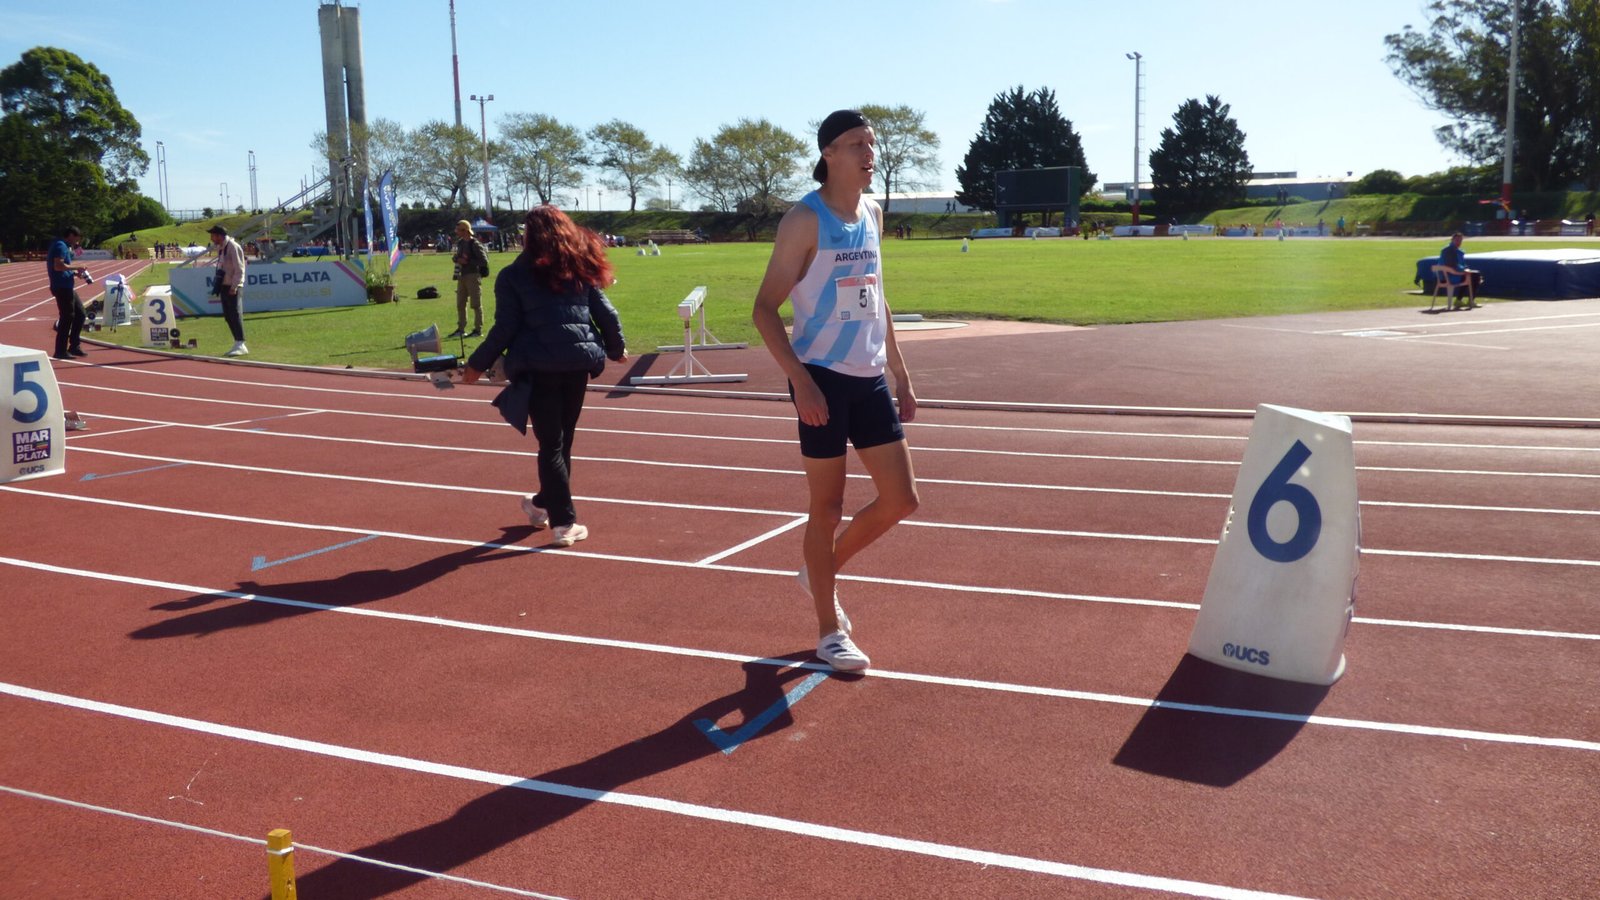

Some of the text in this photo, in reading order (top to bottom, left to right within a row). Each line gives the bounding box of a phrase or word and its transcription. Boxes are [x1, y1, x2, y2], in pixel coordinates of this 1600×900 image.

[835, 250, 877, 262] ARGENTINA
[247, 271, 331, 286] DEL PLATA
[859, 288, 868, 308] 5
[149, 298, 167, 325] 3
[12, 360, 49, 424] 5
[15, 429, 49, 444] MAR
[16, 443, 36, 453] DEL
[16, 450, 48, 462] PLATA
[1247, 439, 1322, 563] 6
[1235, 644, 1270, 666] UCS
